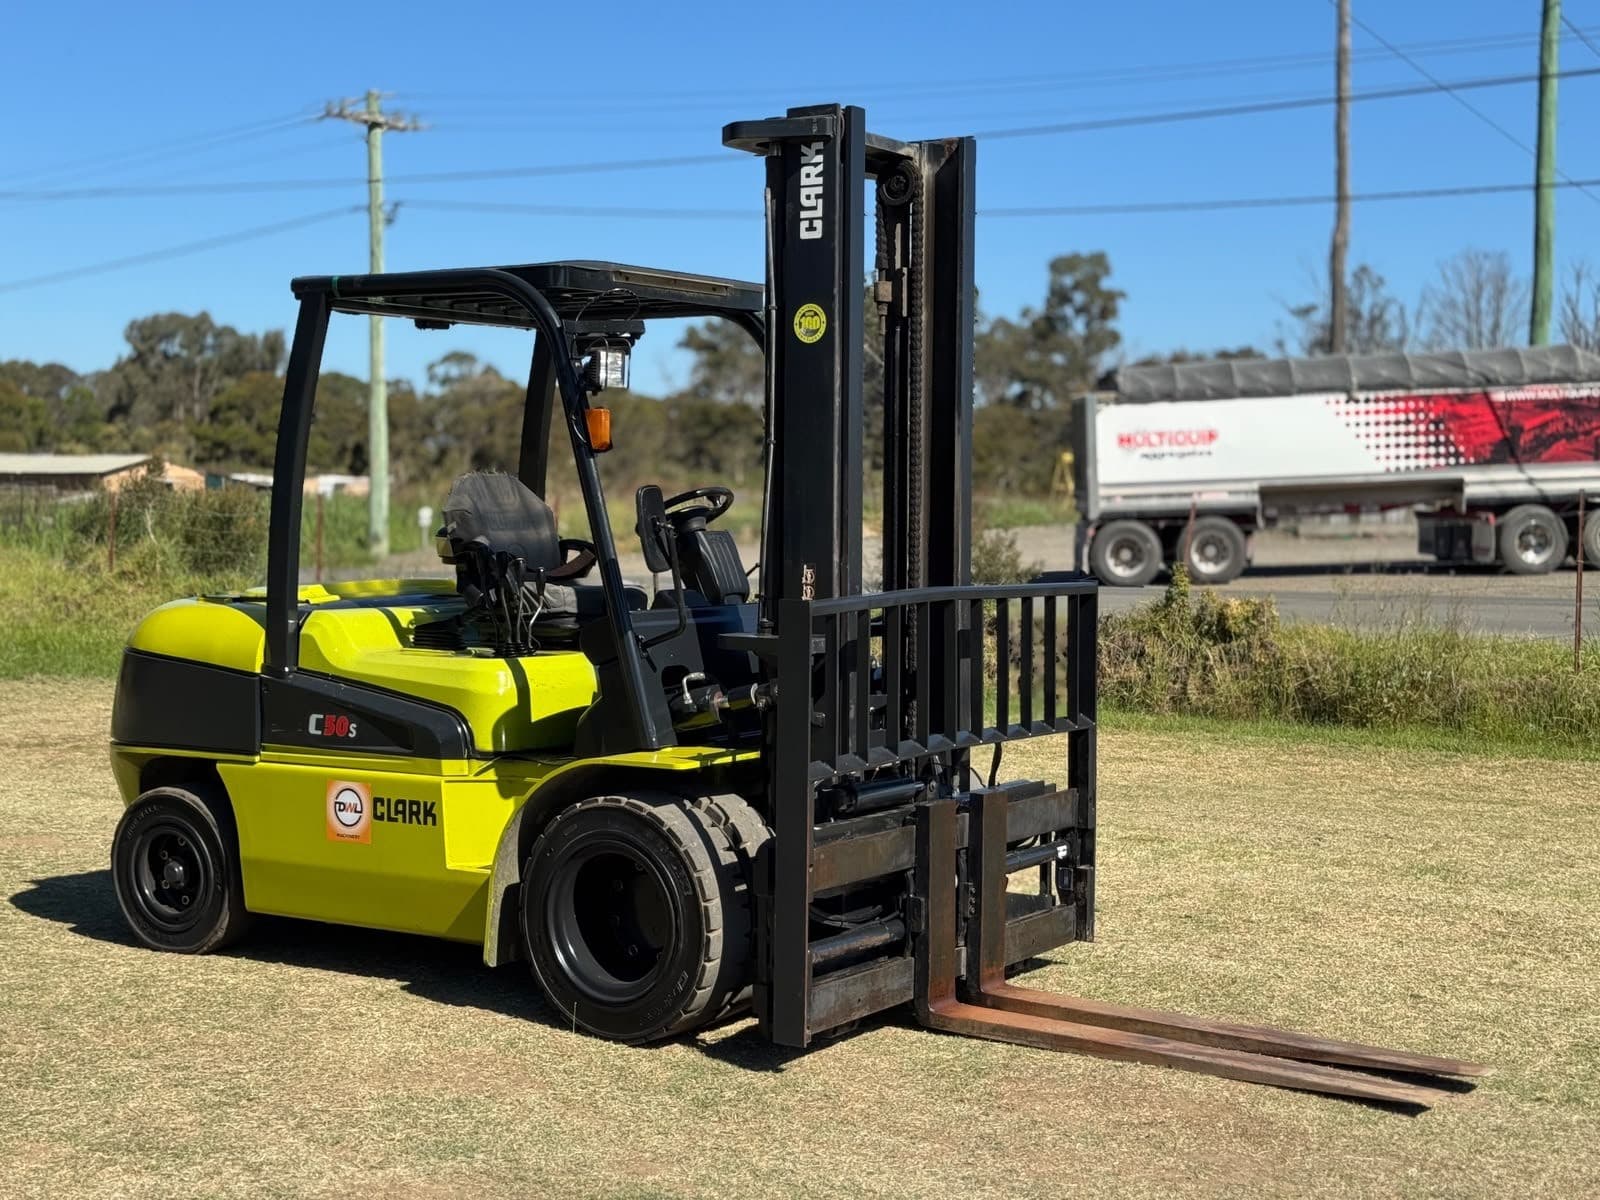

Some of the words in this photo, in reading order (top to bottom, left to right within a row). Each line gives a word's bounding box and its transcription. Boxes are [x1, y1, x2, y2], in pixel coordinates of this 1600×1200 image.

[800, 142, 824, 240] CLARK
[800, 316, 820, 330] 100
[1117, 428, 1219, 448] MULTIQUIP
[335, 800, 362, 815] DWL
[373, 796, 437, 827] CLARK
